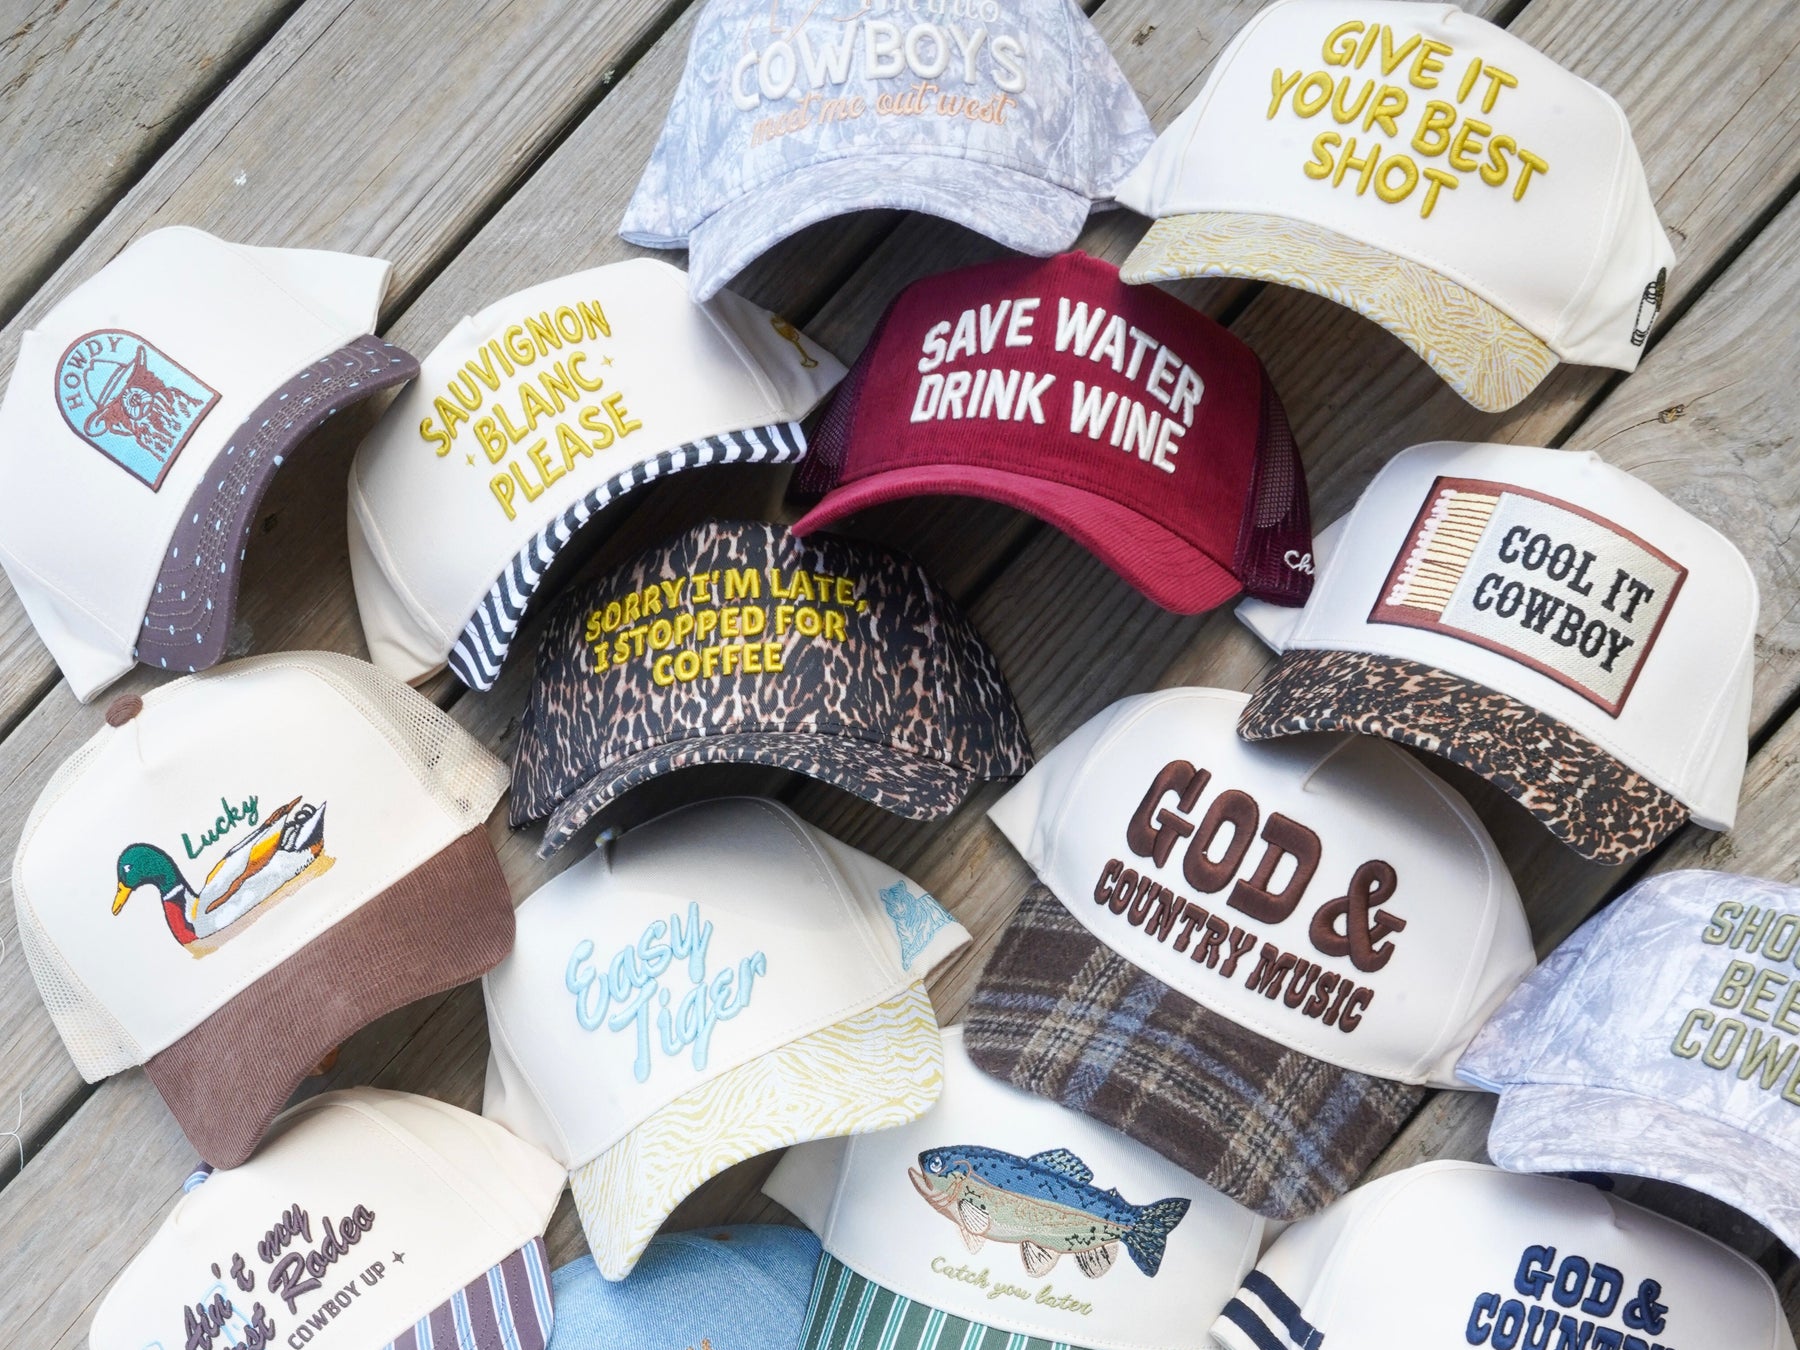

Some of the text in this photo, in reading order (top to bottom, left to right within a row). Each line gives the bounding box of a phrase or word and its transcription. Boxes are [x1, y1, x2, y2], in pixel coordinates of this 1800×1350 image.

[731, 19, 1026, 111] COWBOYS
[1322, 20, 1519, 114] GIVE IT
[751, 81, 1017, 148] meet me out west
[1267, 67, 1549, 202] YOUR BEST
[1303, 131, 1459, 218] SHOT
[66, 335, 124, 409] HOWDY
[419, 299, 611, 458] SAUVIGNON
[473, 351, 604, 464] BLANC
[918, 296, 1205, 428] SAVE WATER
[488, 391, 643, 520] PLEASE
[909, 369, 1186, 474] DRINK WINE
[585, 568, 868, 643] SORRY I'M LATE,
[1499, 524, 1655, 624] COOL IT
[594, 605, 847, 674] I STOPPED FOR
[653, 643, 784, 686] COFFEE
[1473, 571, 1635, 674] COWBOY
[182, 795, 259, 860] Lucky
[1126, 758, 1406, 973] GOD &
[566, 901, 713, 1032] Easy
[1093, 858, 1375, 1033] COUNTRY MUSIC
[1702, 901, 1800, 970] SHO
[609, 951, 766, 1083] Tiger
[257, 1203, 312, 1264] my
[267, 1204, 375, 1315] Rodeo
[287, 1261, 386, 1350] COWBOY UP
[930, 1255, 1093, 1317] Catch you later
[1514, 1244, 1668, 1336] GOD &
